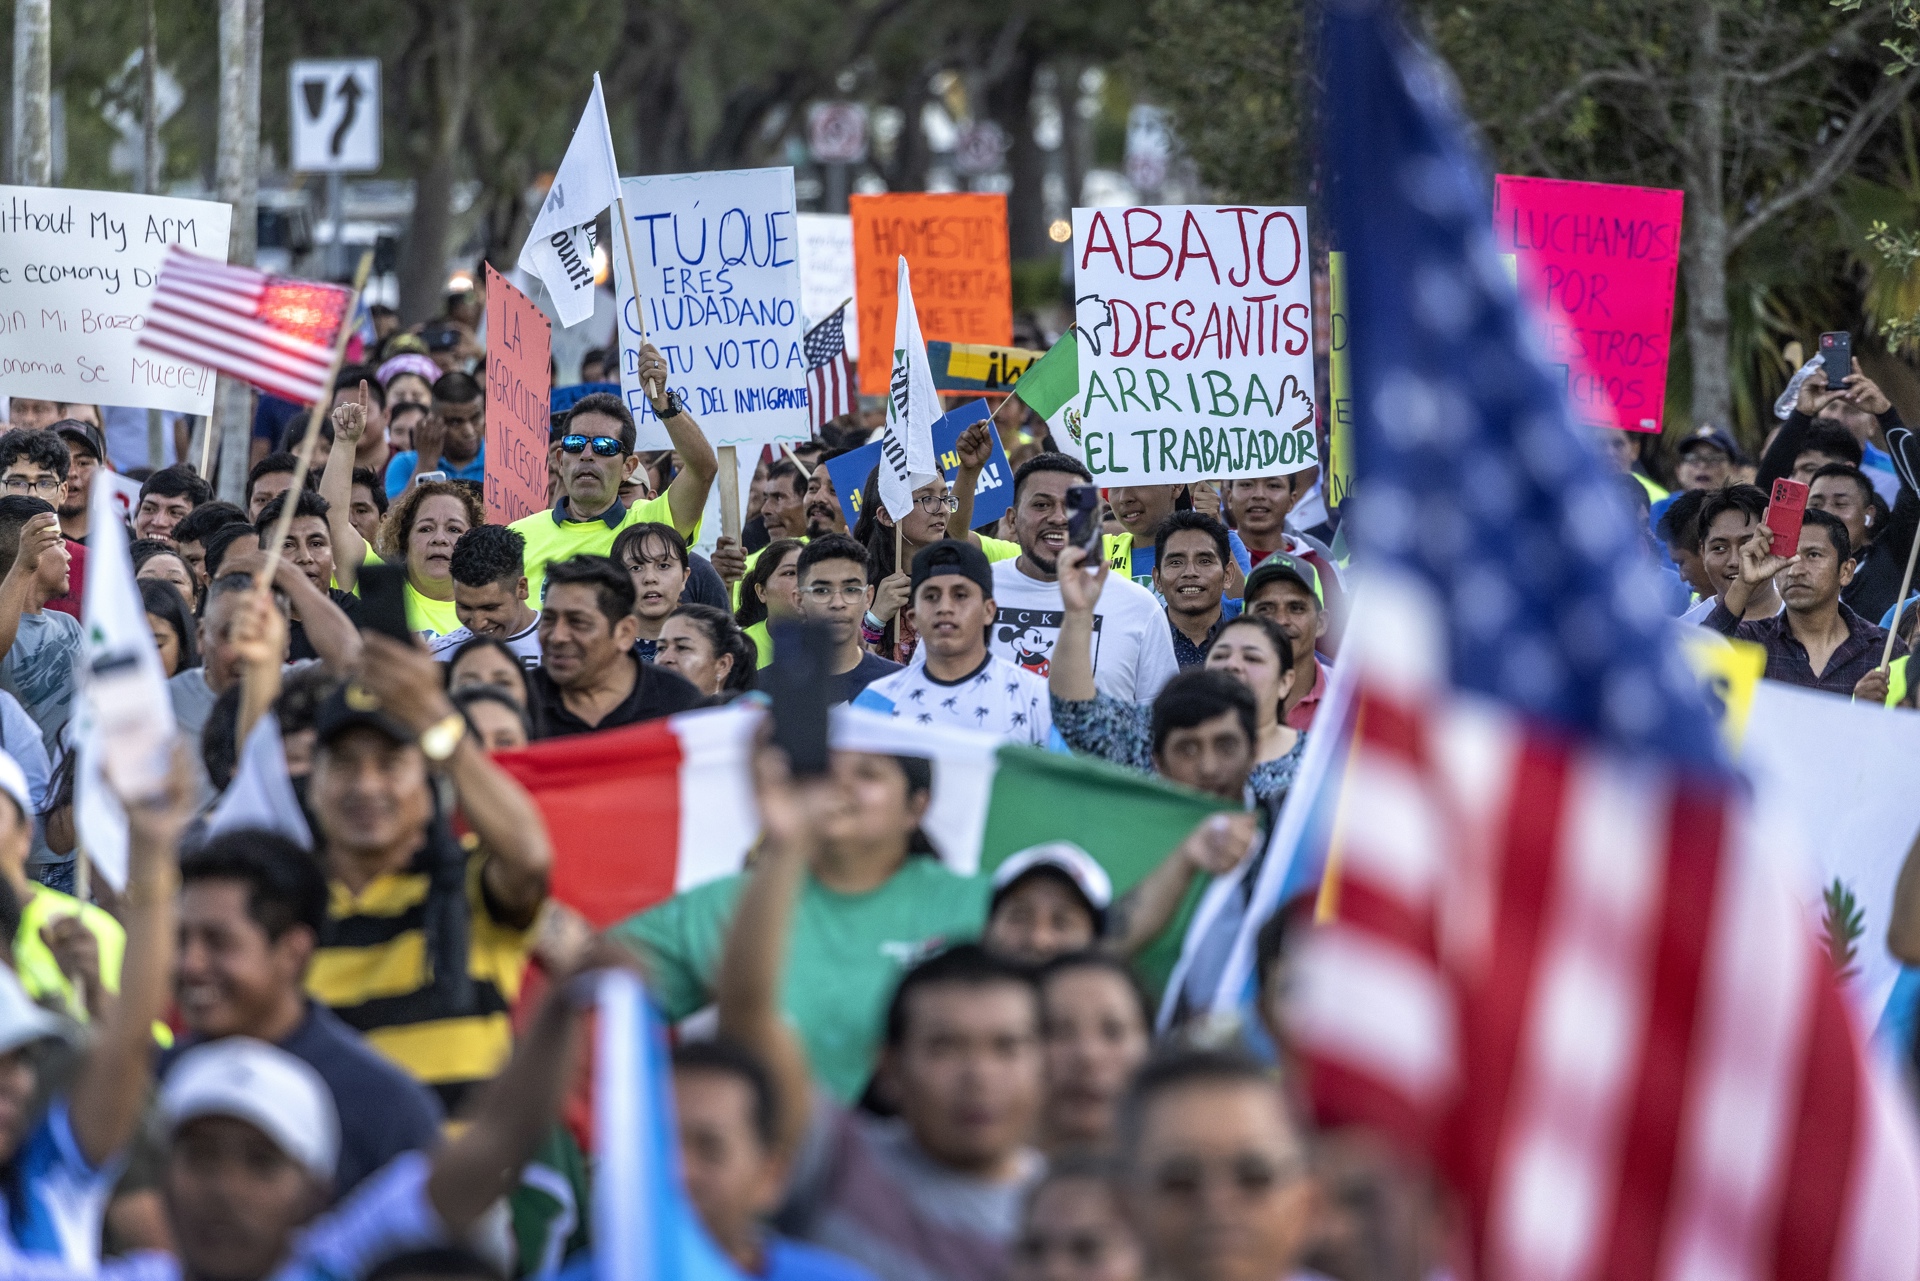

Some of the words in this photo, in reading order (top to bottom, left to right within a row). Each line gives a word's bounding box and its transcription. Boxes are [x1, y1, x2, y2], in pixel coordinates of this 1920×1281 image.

[2, 196, 76, 235] ithout
[91, 212, 127, 252] My
[634, 200, 706, 267] TÚ
[718, 207, 795, 269] QUE
[1082, 207, 1301, 287] ABAJO
[1513, 208, 1671, 262] LUCHAMOS
[550, 231, 595, 291] ount!
[663, 263, 734, 295] ERES
[1543, 264, 1611, 317] POR
[41, 308, 67, 333] Mi
[81, 308, 147, 334] Brazo
[503, 300, 523, 360] LA
[624, 296, 795, 337] CIUDADANO
[1107, 294, 1309, 360] DESANTIS
[0, 358, 67, 380] onomia
[77, 355, 110, 383] Se
[660, 344, 694, 374] TU
[704, 338, 779, 371] VOTO
[785, 341, 804, 369] A
[1544, 323, 1663, 368] ESTROS
[488, 350, 551, 448] AGRICULTURA
[696, 386, 729, 416] DEL
[734, 386, 810, 414] INMIGRANTE
[1082, 367, 1275, 418] ARRIBA
[498, 421, 543, 503] NECESITA
[1084, 431, 1129, 474] EL
[1131, 427, 1319, 474] TRABAJADOR
[487, 472, 502, 510] DE
[997, 609, 1100, 629] ICKY
